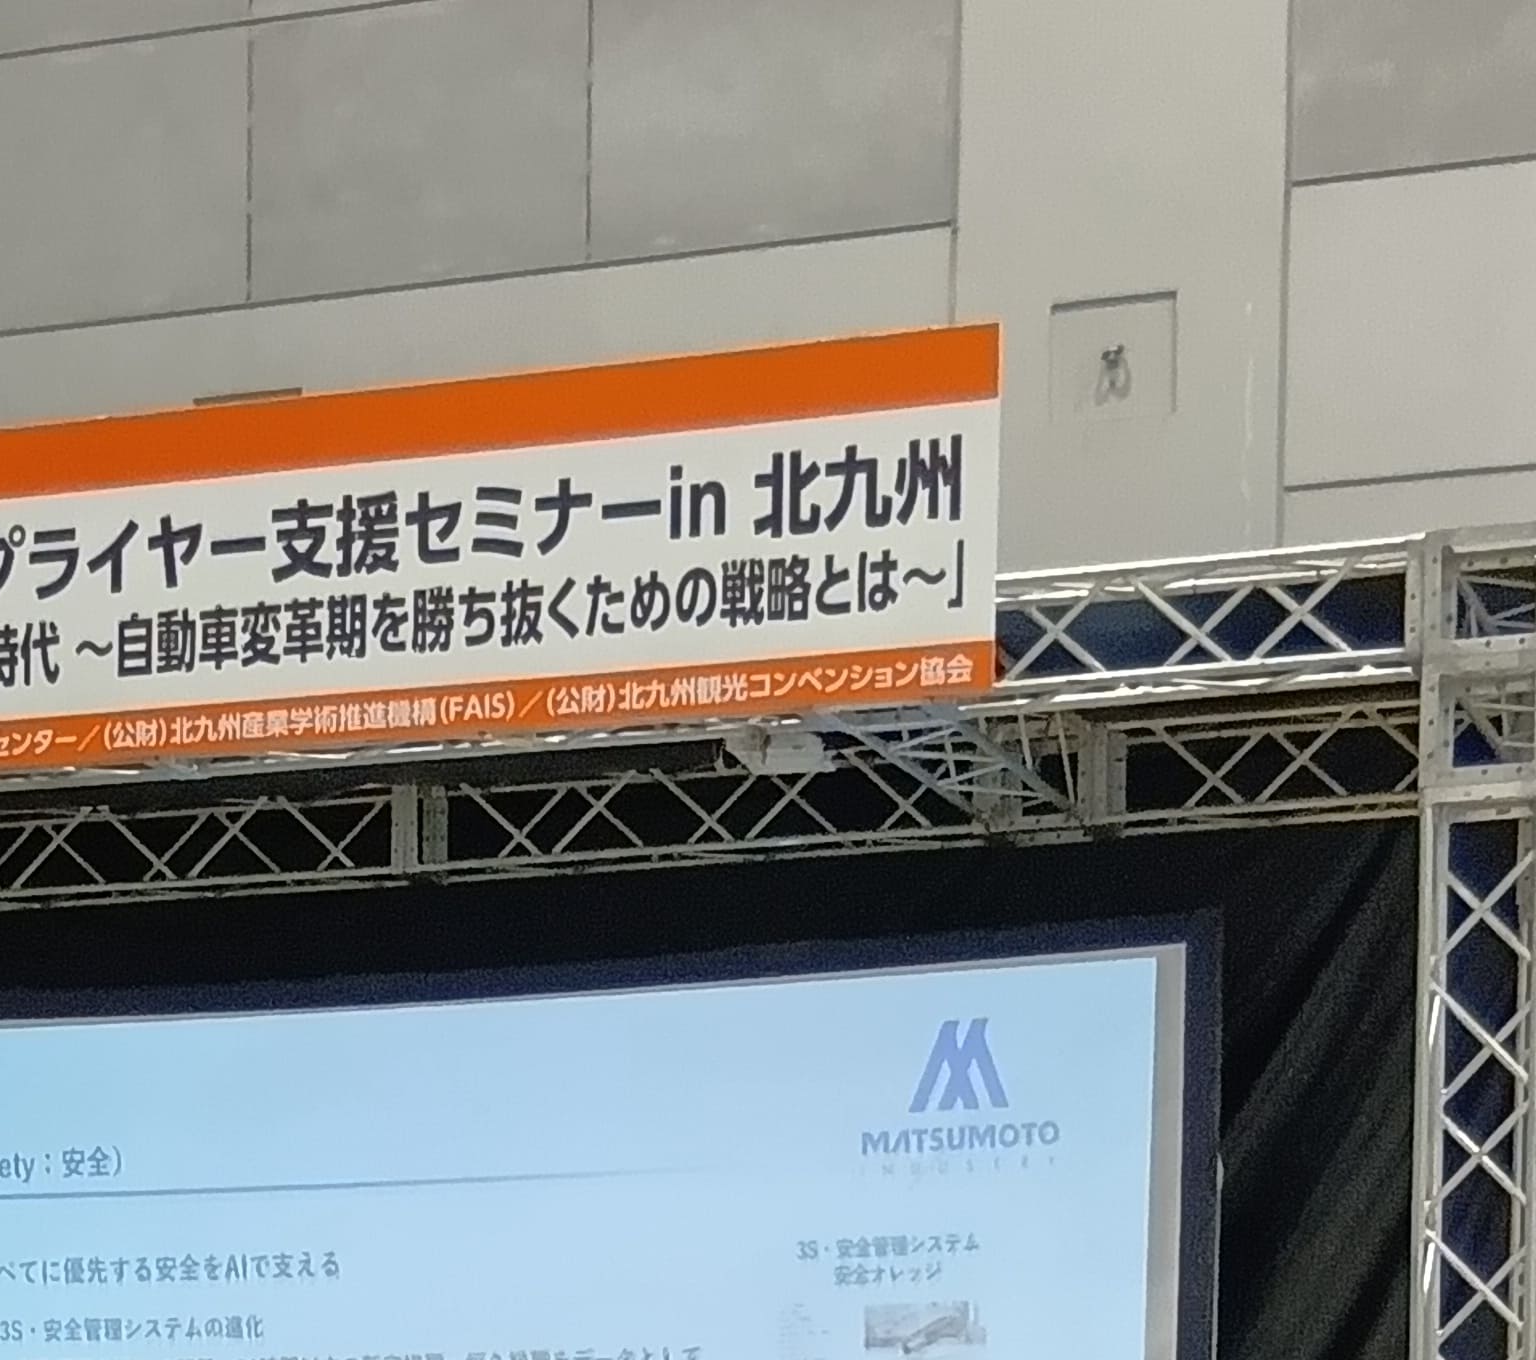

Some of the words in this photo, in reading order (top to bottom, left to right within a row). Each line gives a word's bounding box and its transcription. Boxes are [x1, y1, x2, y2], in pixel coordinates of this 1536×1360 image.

[753, 433, 964, 540] 北九州
[861, 1120, 1061, 1155] MATSUMOTO
